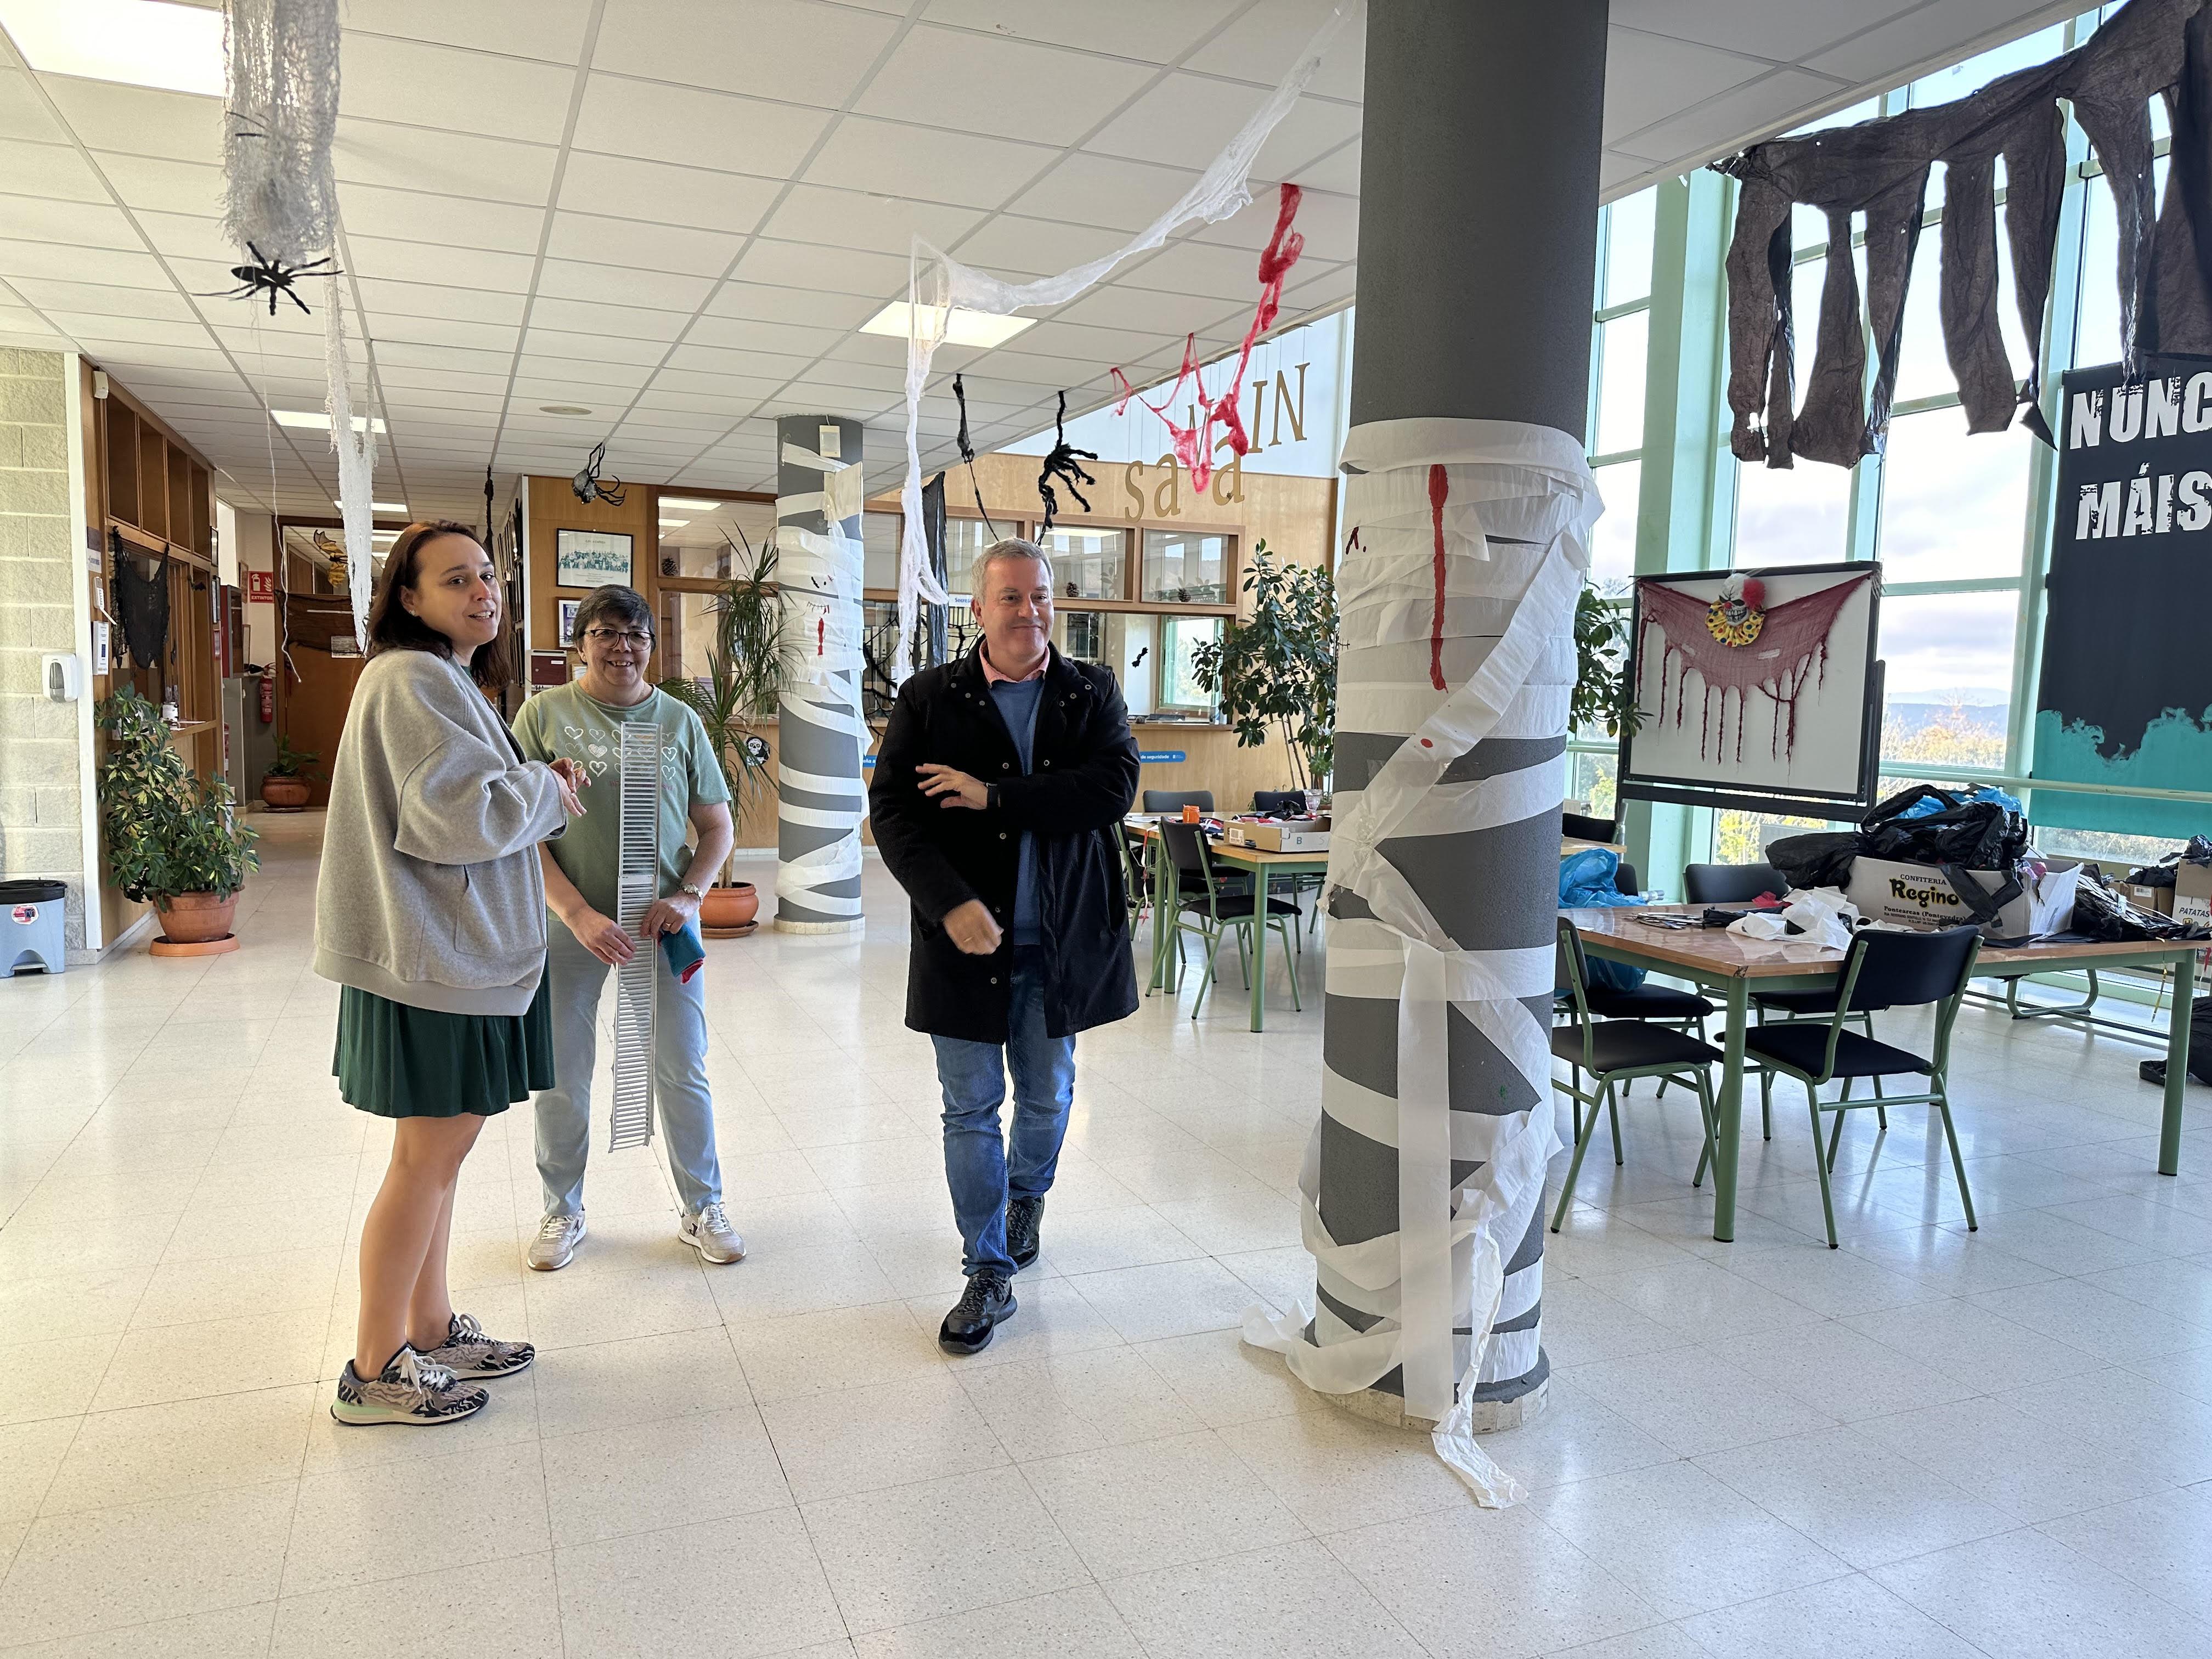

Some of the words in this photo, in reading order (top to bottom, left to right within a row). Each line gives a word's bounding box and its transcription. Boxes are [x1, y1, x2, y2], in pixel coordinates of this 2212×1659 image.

[2075, 462, 2212, 540] MÁIS
[1900, 874, 1947, 885] CONFITERIA
[1889, 878, 1959, 908] Regino
[1884, 906, 1920, 916] Ponteareas
[2179, 907, 2210, 918] PATATAS
